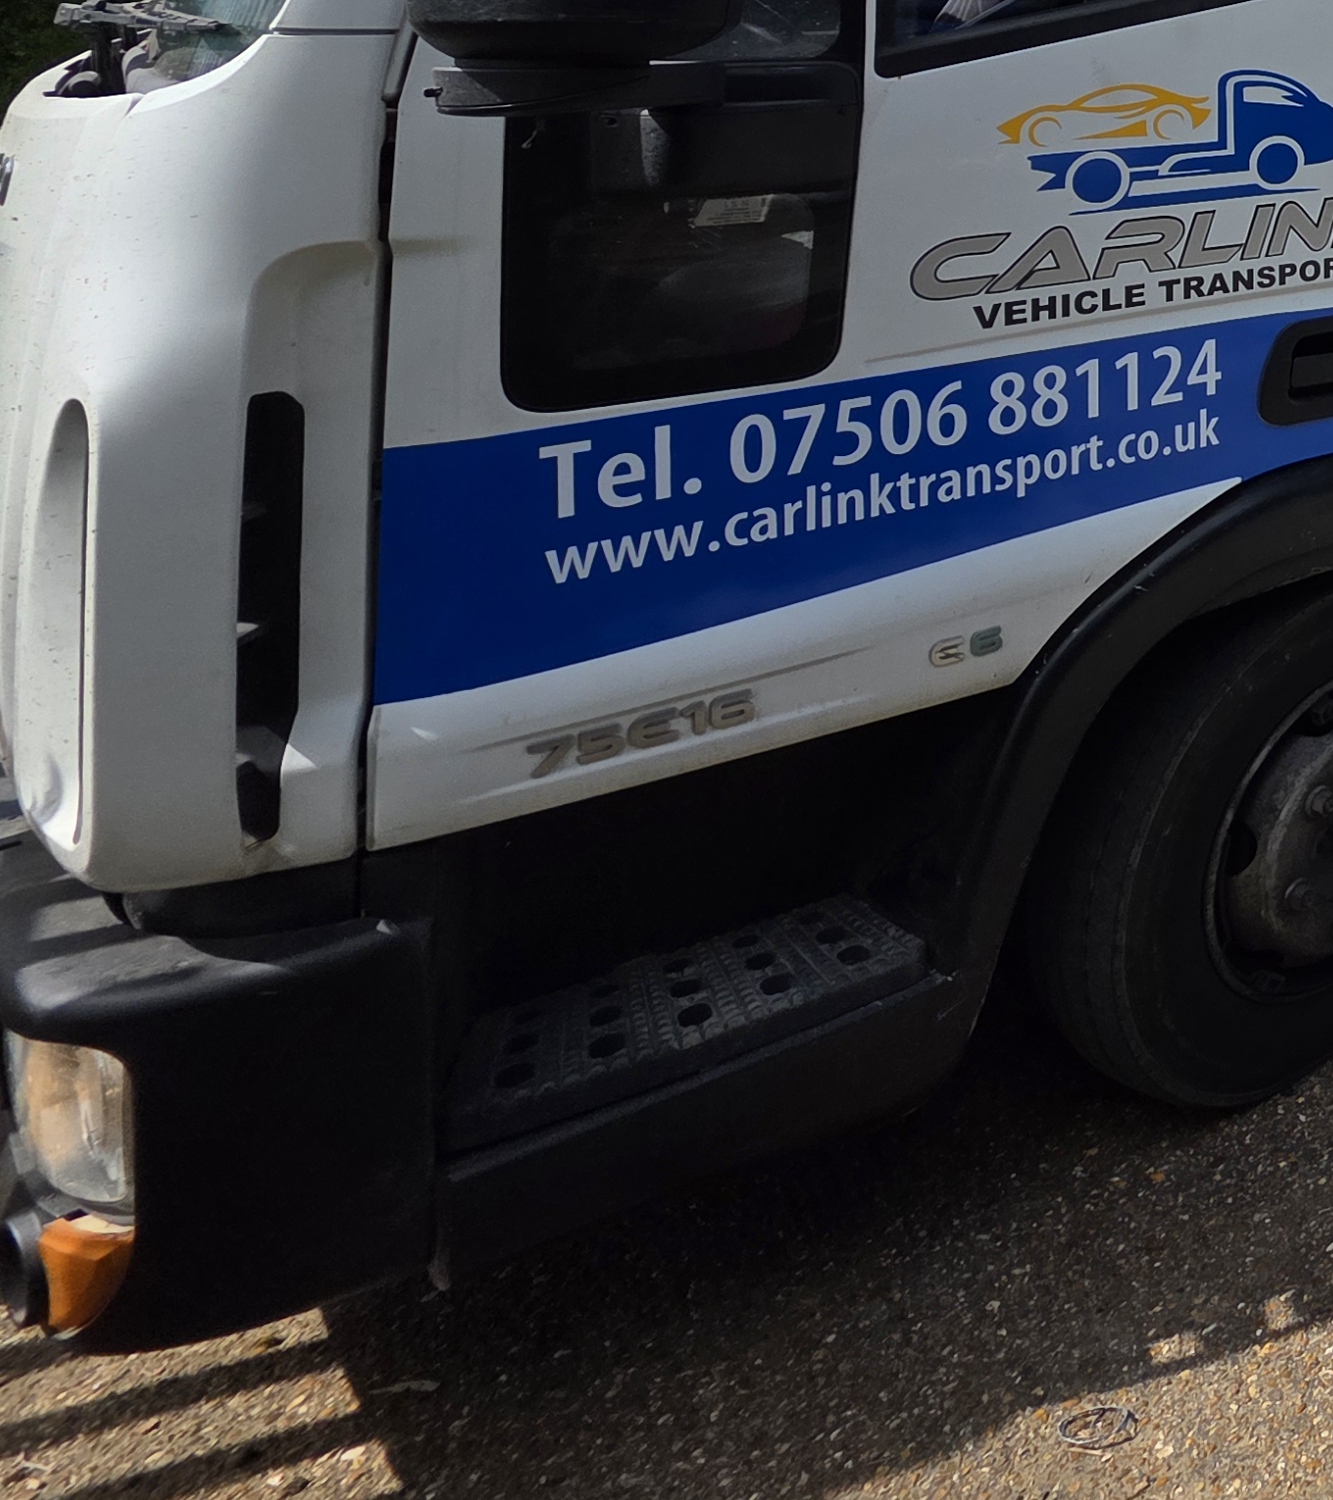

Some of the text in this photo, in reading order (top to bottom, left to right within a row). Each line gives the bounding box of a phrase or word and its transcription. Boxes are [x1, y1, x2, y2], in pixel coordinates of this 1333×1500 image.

[973, 284, 1146, 329] VEHICLE
[538, 338, 1222, 519] Tel. 07506 881124
[545, 409, 1221, 584] www.carlinktransport.co.uk
[526, 688, 758, 778] 75E16
